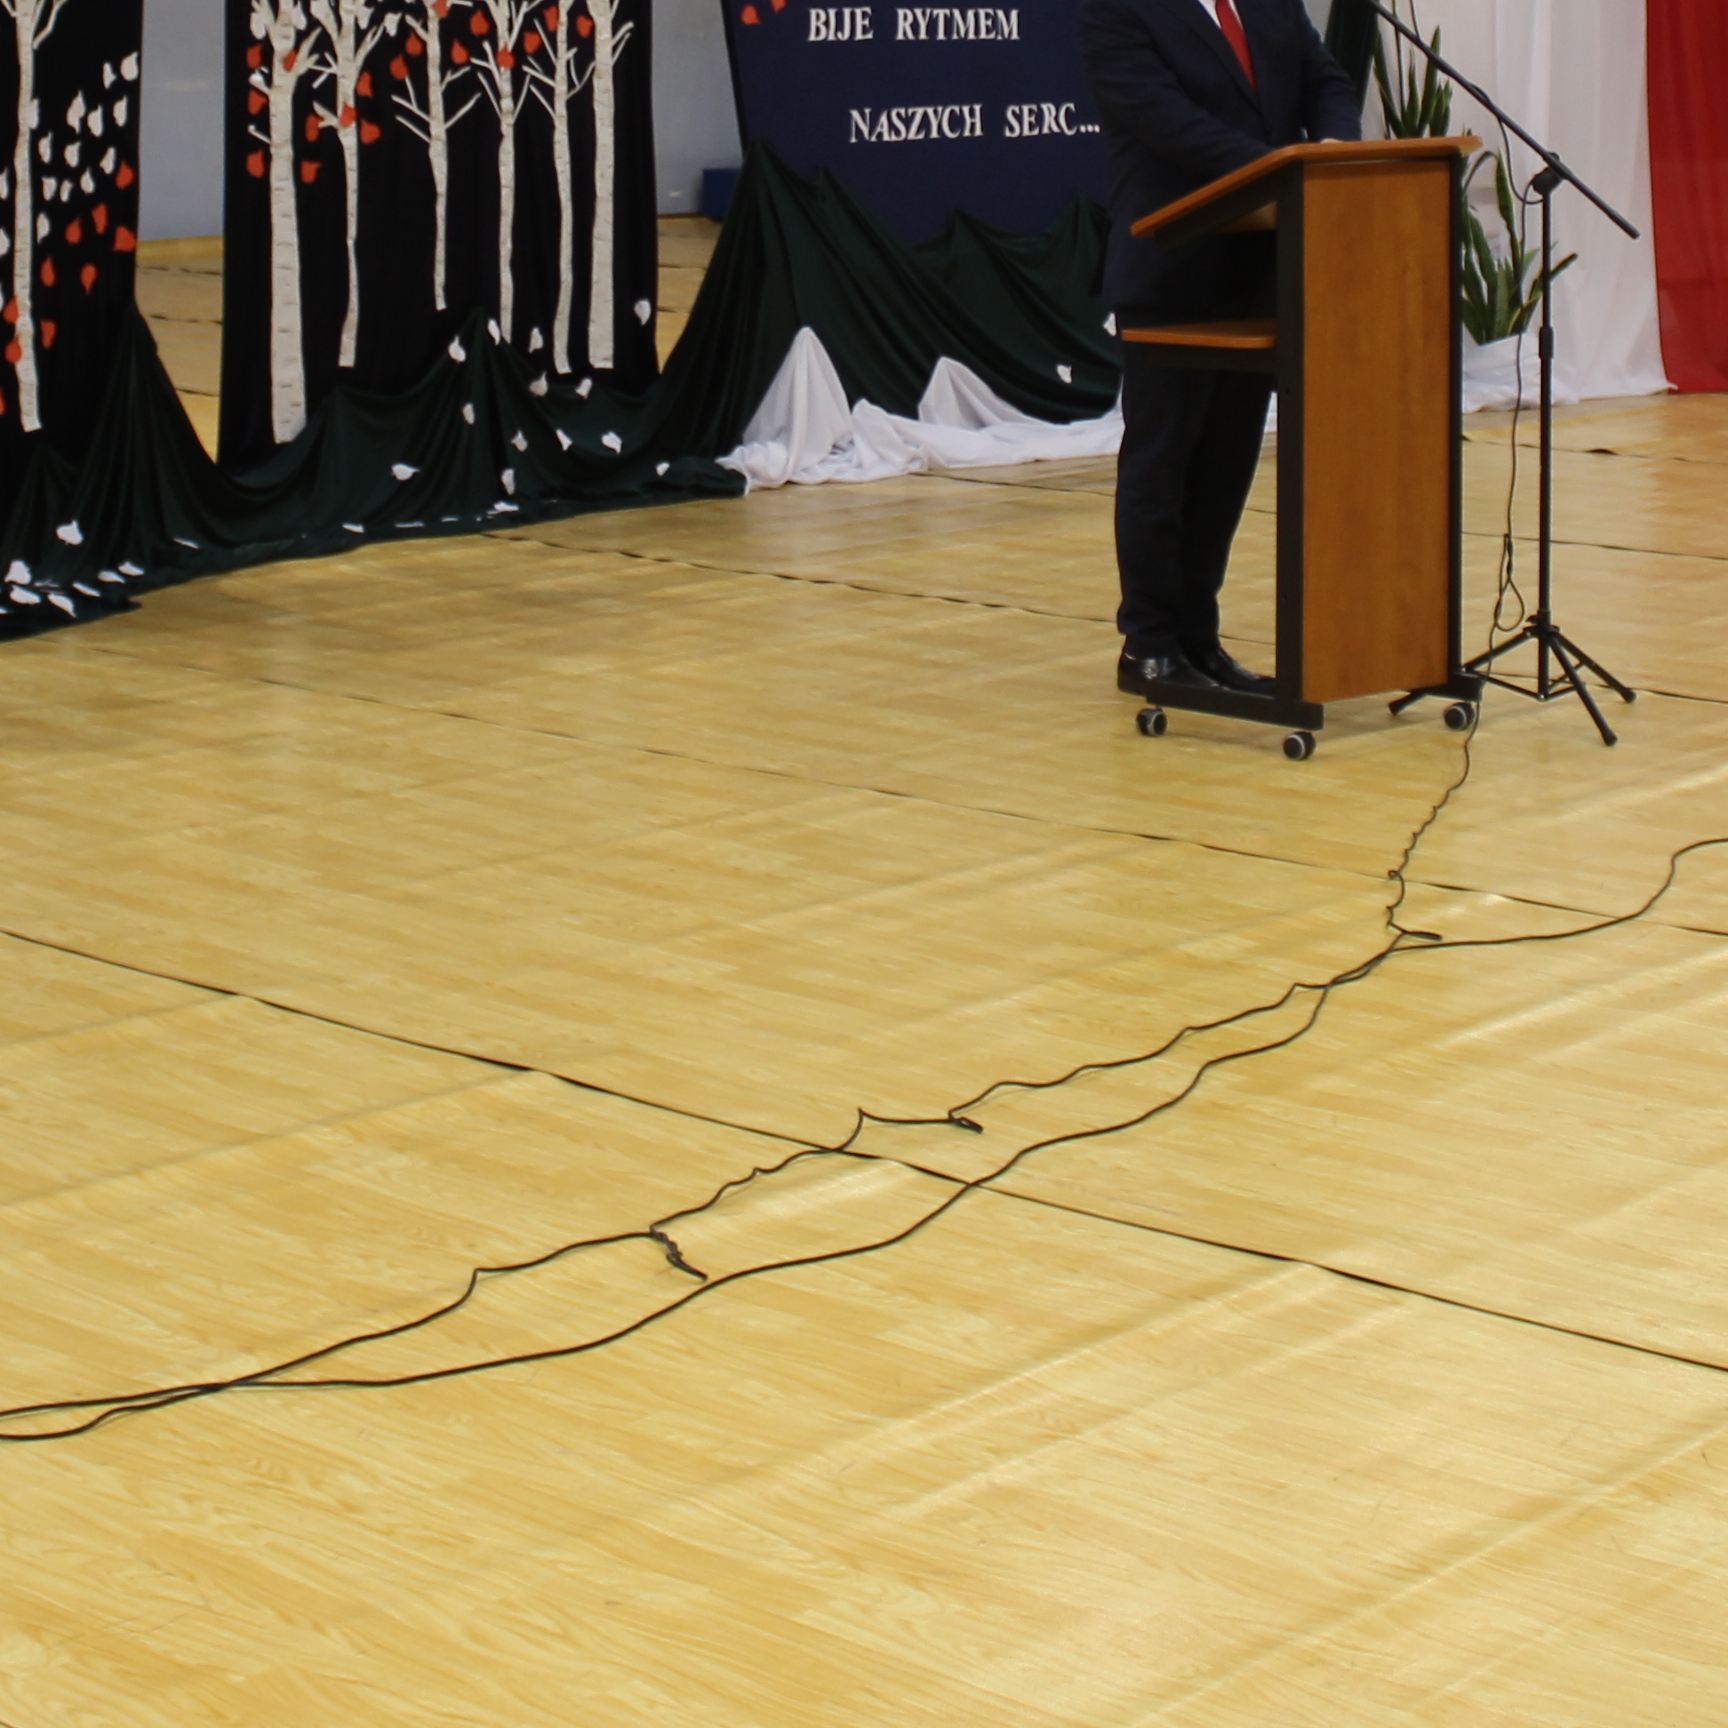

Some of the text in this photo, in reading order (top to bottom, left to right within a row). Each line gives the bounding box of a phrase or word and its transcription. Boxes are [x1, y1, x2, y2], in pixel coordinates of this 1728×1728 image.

[807, 6, 1020, 42] BIJE RYTMEM
[849, 102, 1100, 143] NASZYCH SERC...
